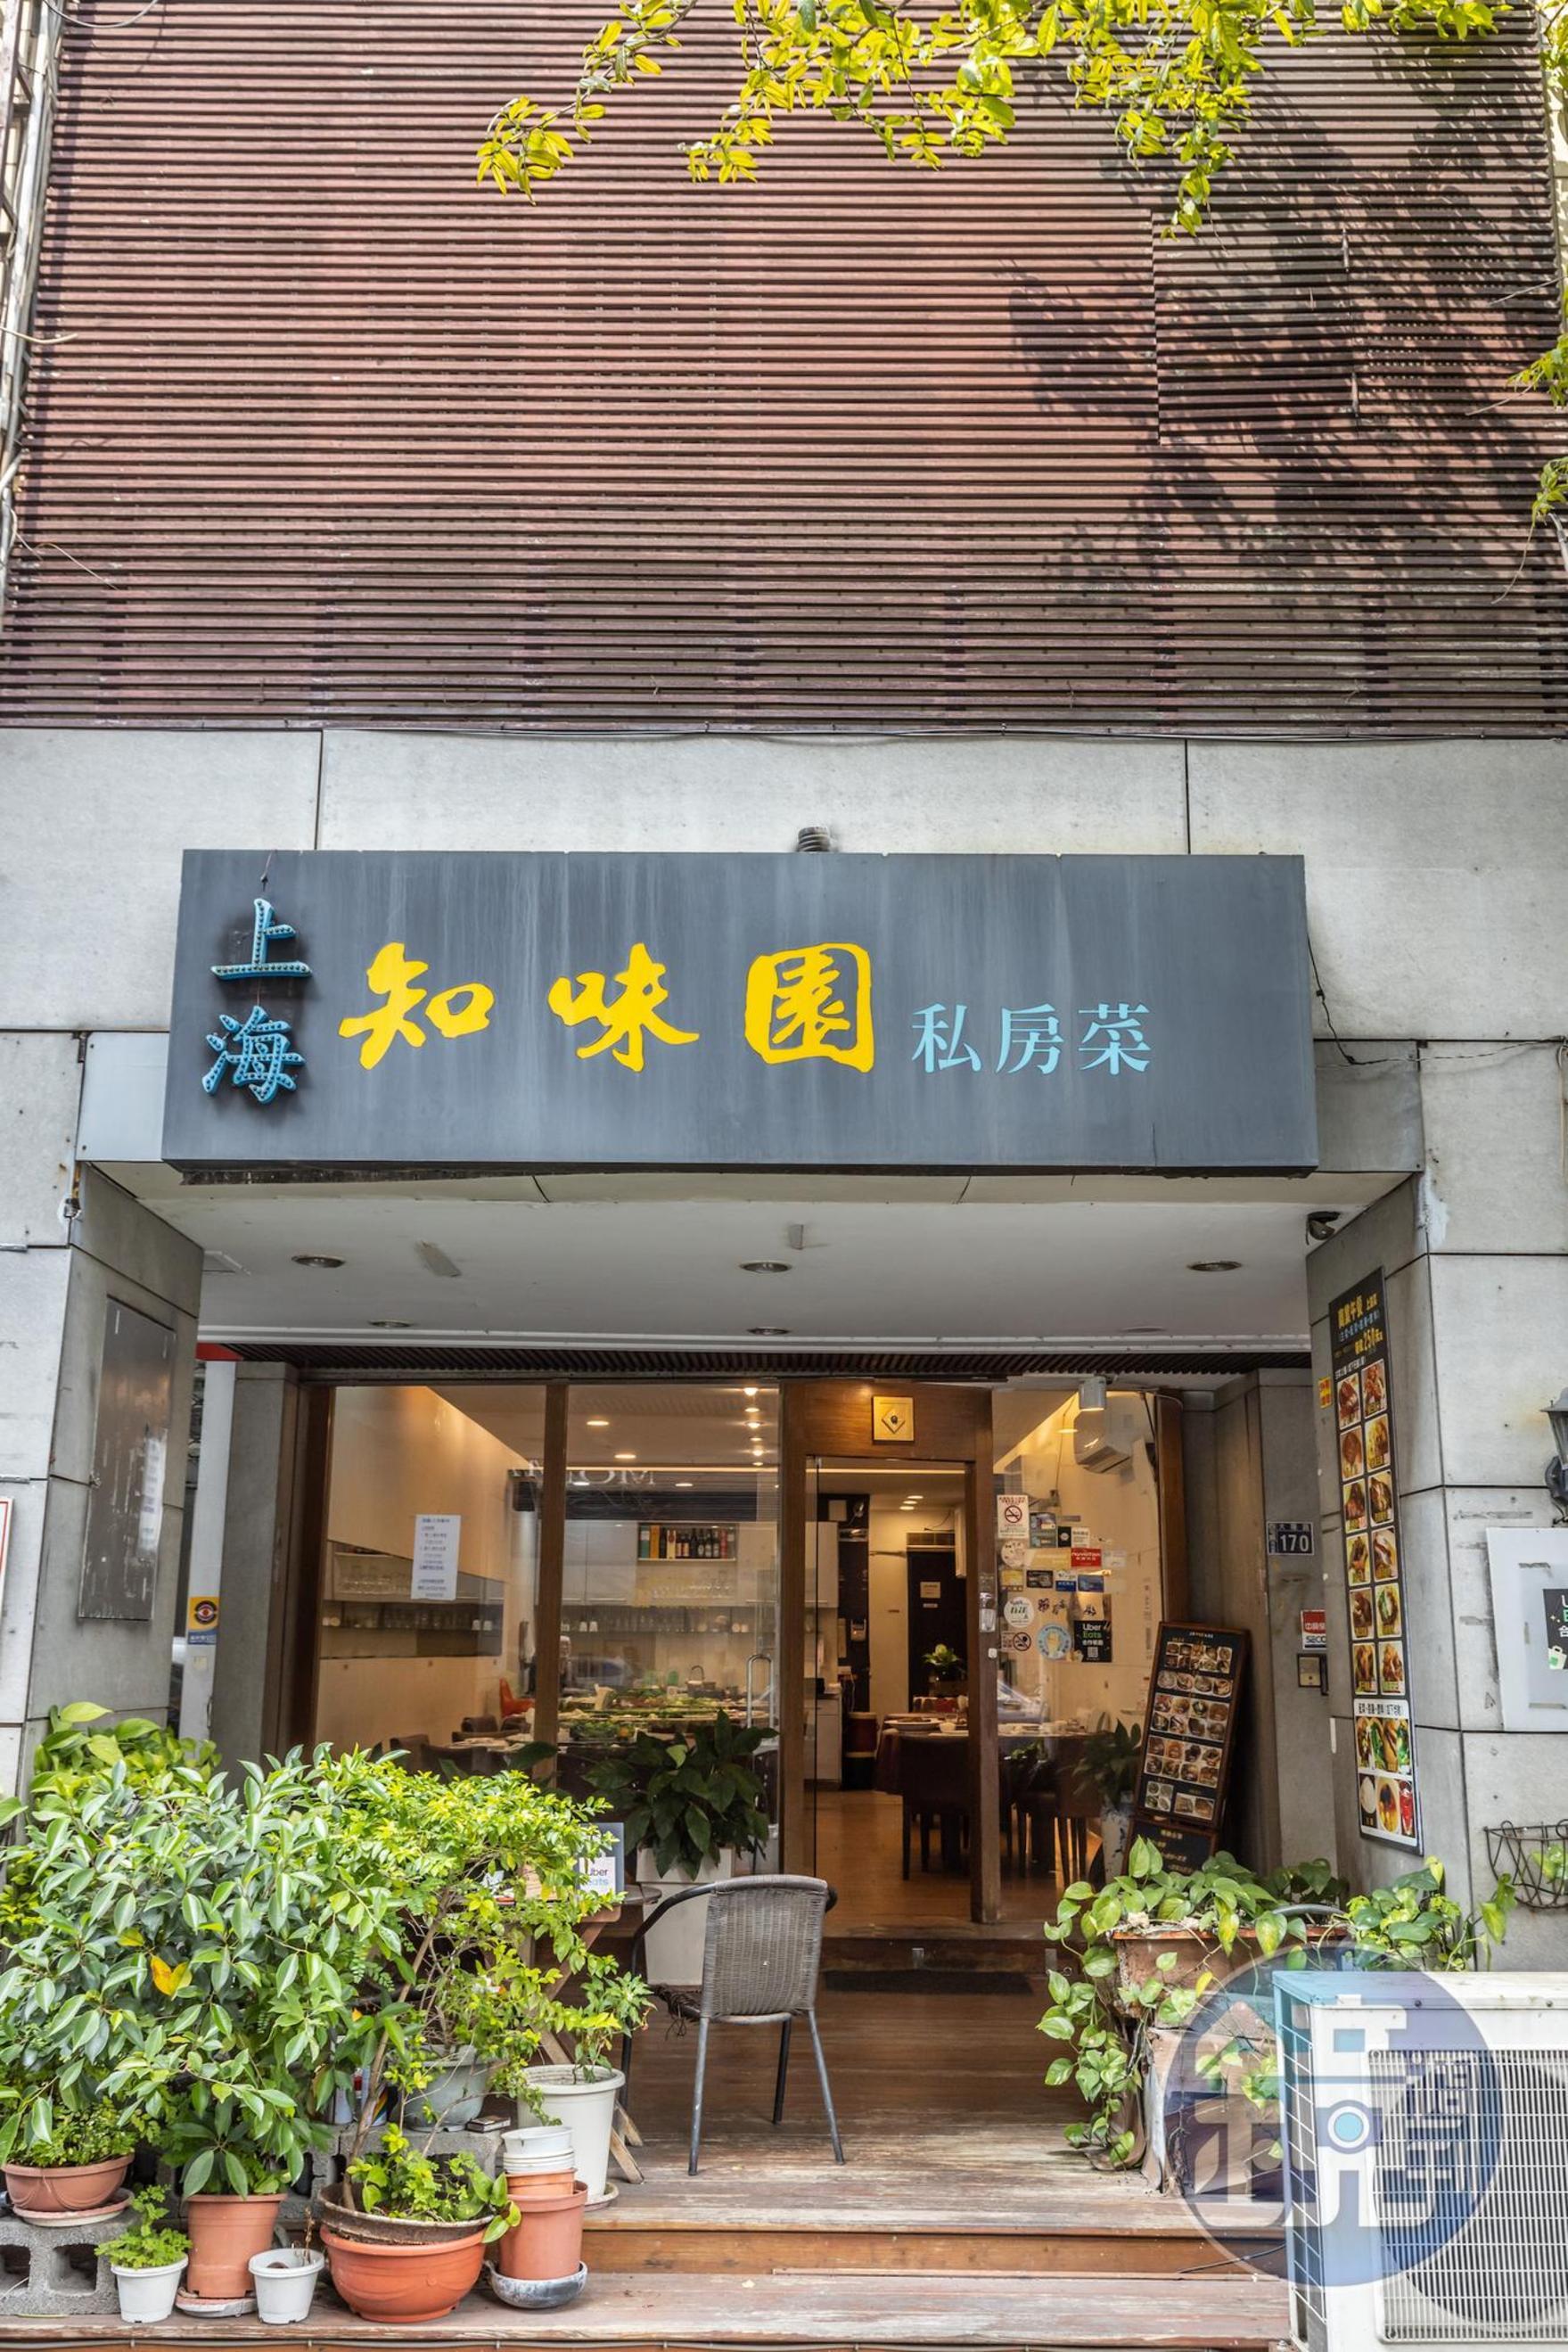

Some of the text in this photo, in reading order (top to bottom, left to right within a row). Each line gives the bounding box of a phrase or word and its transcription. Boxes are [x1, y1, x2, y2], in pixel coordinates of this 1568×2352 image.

[201, 898, 313, 1104] 上海
[338, 942, 874, 1073] 知味園
[911, 1003, 1151, 1075] 私房菜
[1280, 1534, 1309, 1552] 170
[1082, 1623, 1102, 1632] Uber
[1082, 1631, 1102, 1639] Eats
